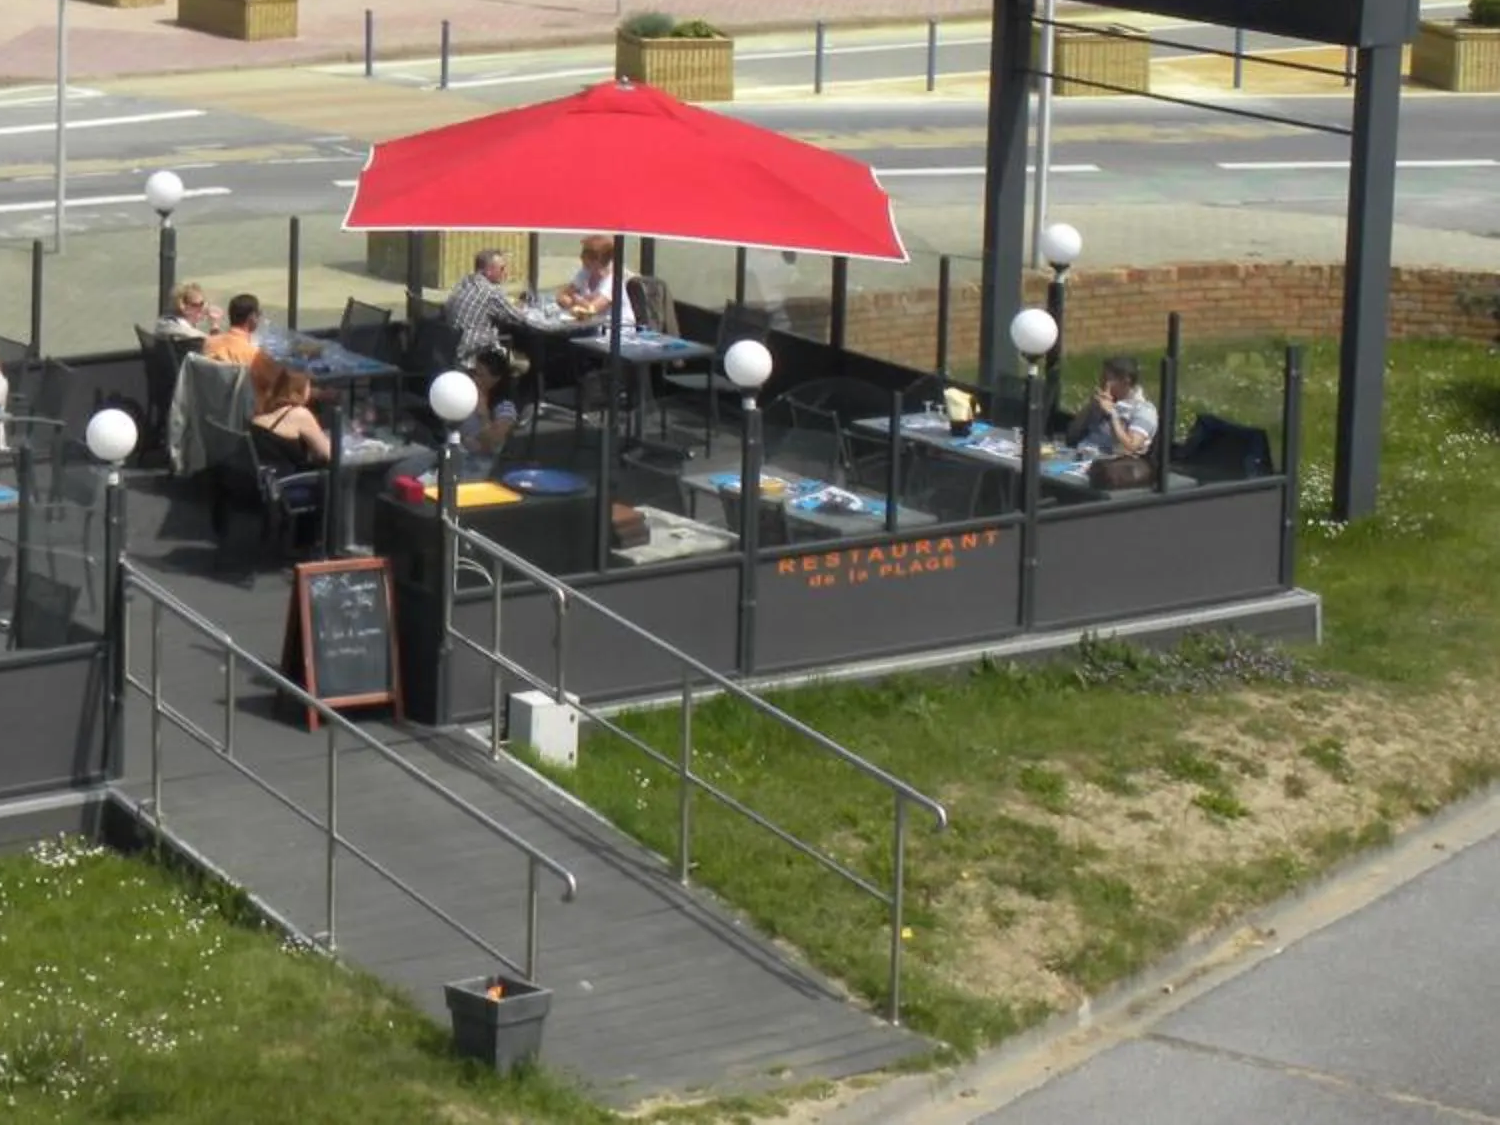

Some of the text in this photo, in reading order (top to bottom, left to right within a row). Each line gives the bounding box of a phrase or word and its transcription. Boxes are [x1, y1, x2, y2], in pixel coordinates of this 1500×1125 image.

[777, 528, 999, 574] RESTAURANT
[808, 574, 836, 588] de
[879, 555, 956, 577] PLAGE
